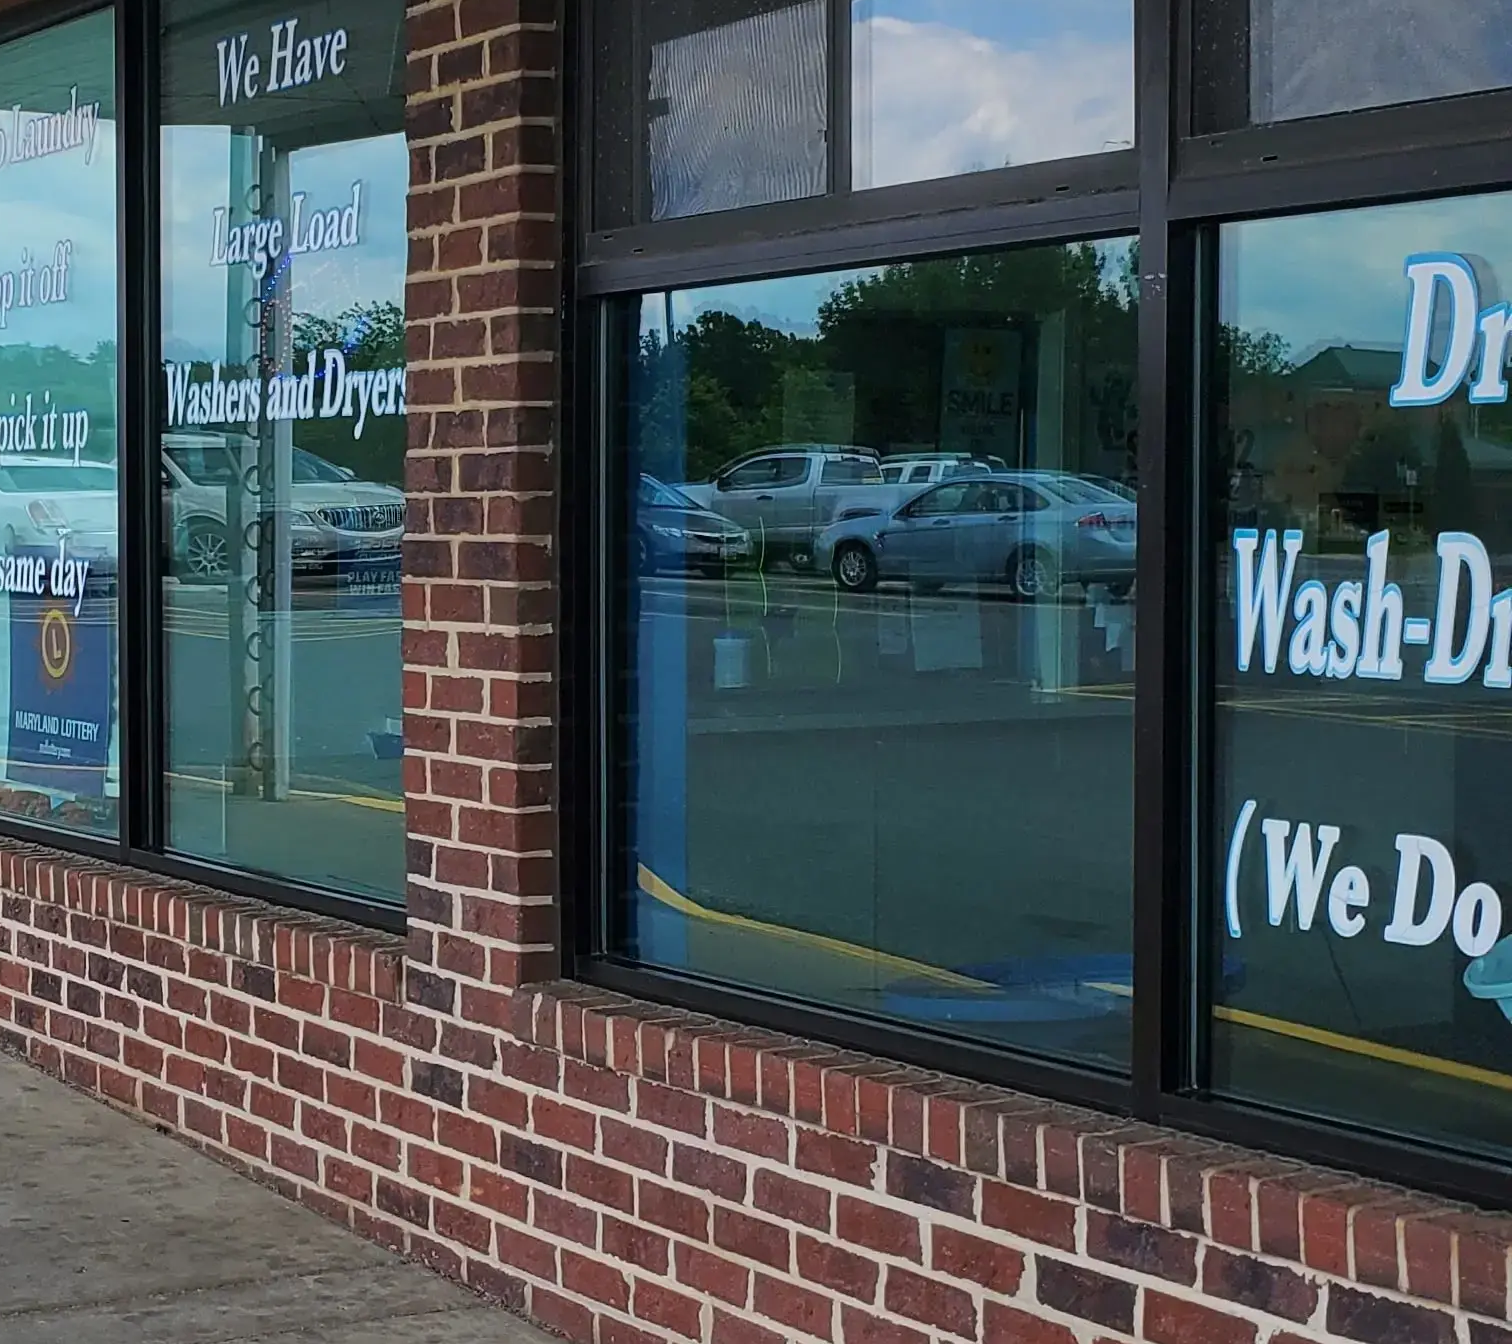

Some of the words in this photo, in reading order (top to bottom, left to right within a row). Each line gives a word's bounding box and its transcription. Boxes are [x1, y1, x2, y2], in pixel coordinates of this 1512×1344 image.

[216, 32, 260, 108] We
[266, 17, 348, 93] Have
[10, 84, 101, 165] Laundry
[209, 207, 285, 281] Large
[288, 179, 362, 254] Load
[19, 247, 36, 306] it
[40, 239, 72, 304] off
[164, 360, 262, 426] Washers
[266, 351, 317, 420] and
[946, 389, 1014, 416] SMILE
[41, 390, 57, 450] it
[62, 409, 88, 467] up
[50, 528, 89, 617] day
[347, 571, 378, 584] PLAY
[15, 710, 59, 735] MARYLAND
[60, 718, 100, 742] LOTTERY
[1225, 799, 1371, 938] (We
[1383, 833, 1503, 957] Do
